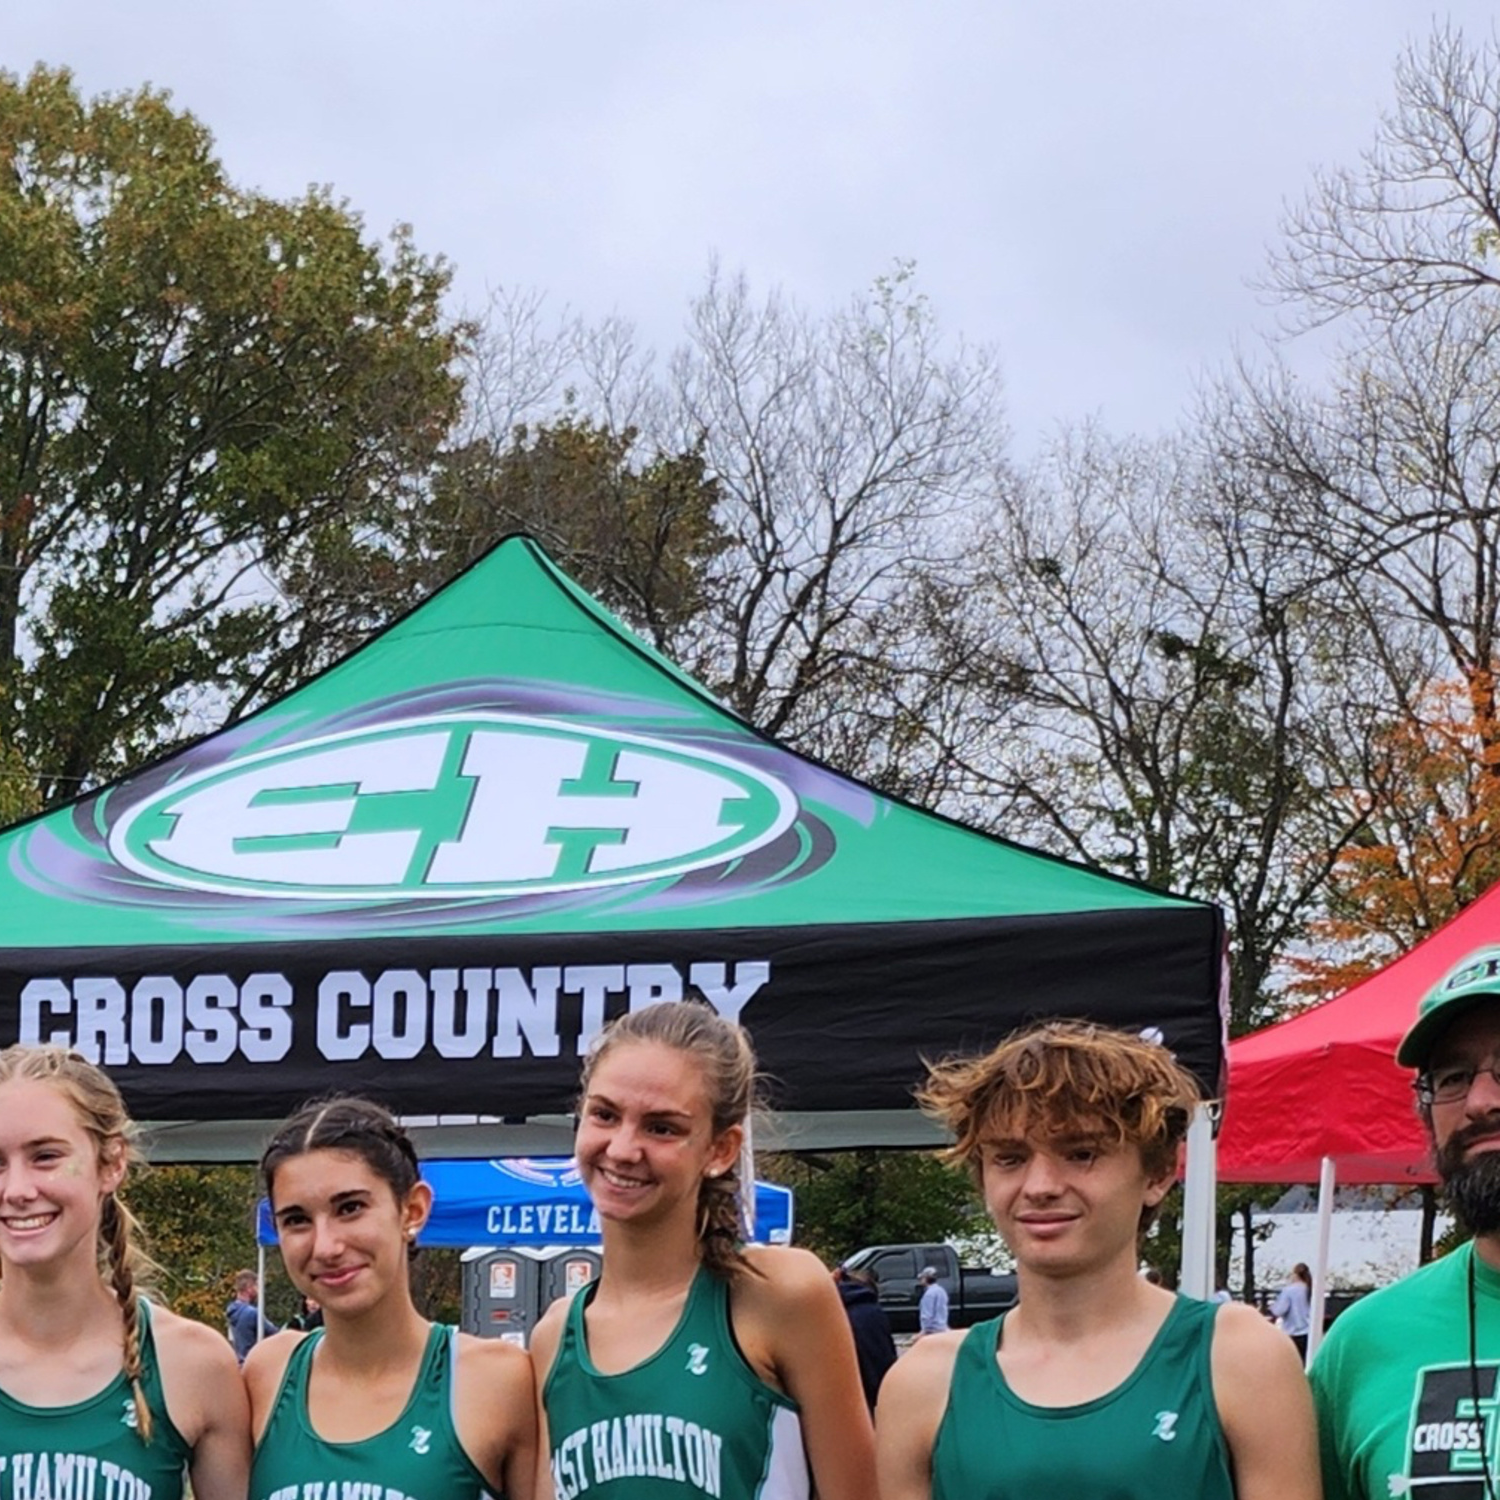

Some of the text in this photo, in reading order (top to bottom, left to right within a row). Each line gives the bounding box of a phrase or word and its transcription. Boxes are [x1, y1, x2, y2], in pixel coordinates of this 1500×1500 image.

[148, 729, 754, 886] EH
[19, 972, 294, 1065] CROSS
[591, 1413, 722, 1499] HAMILTON
[1413, 1421, 1484, 1453] CROSS
